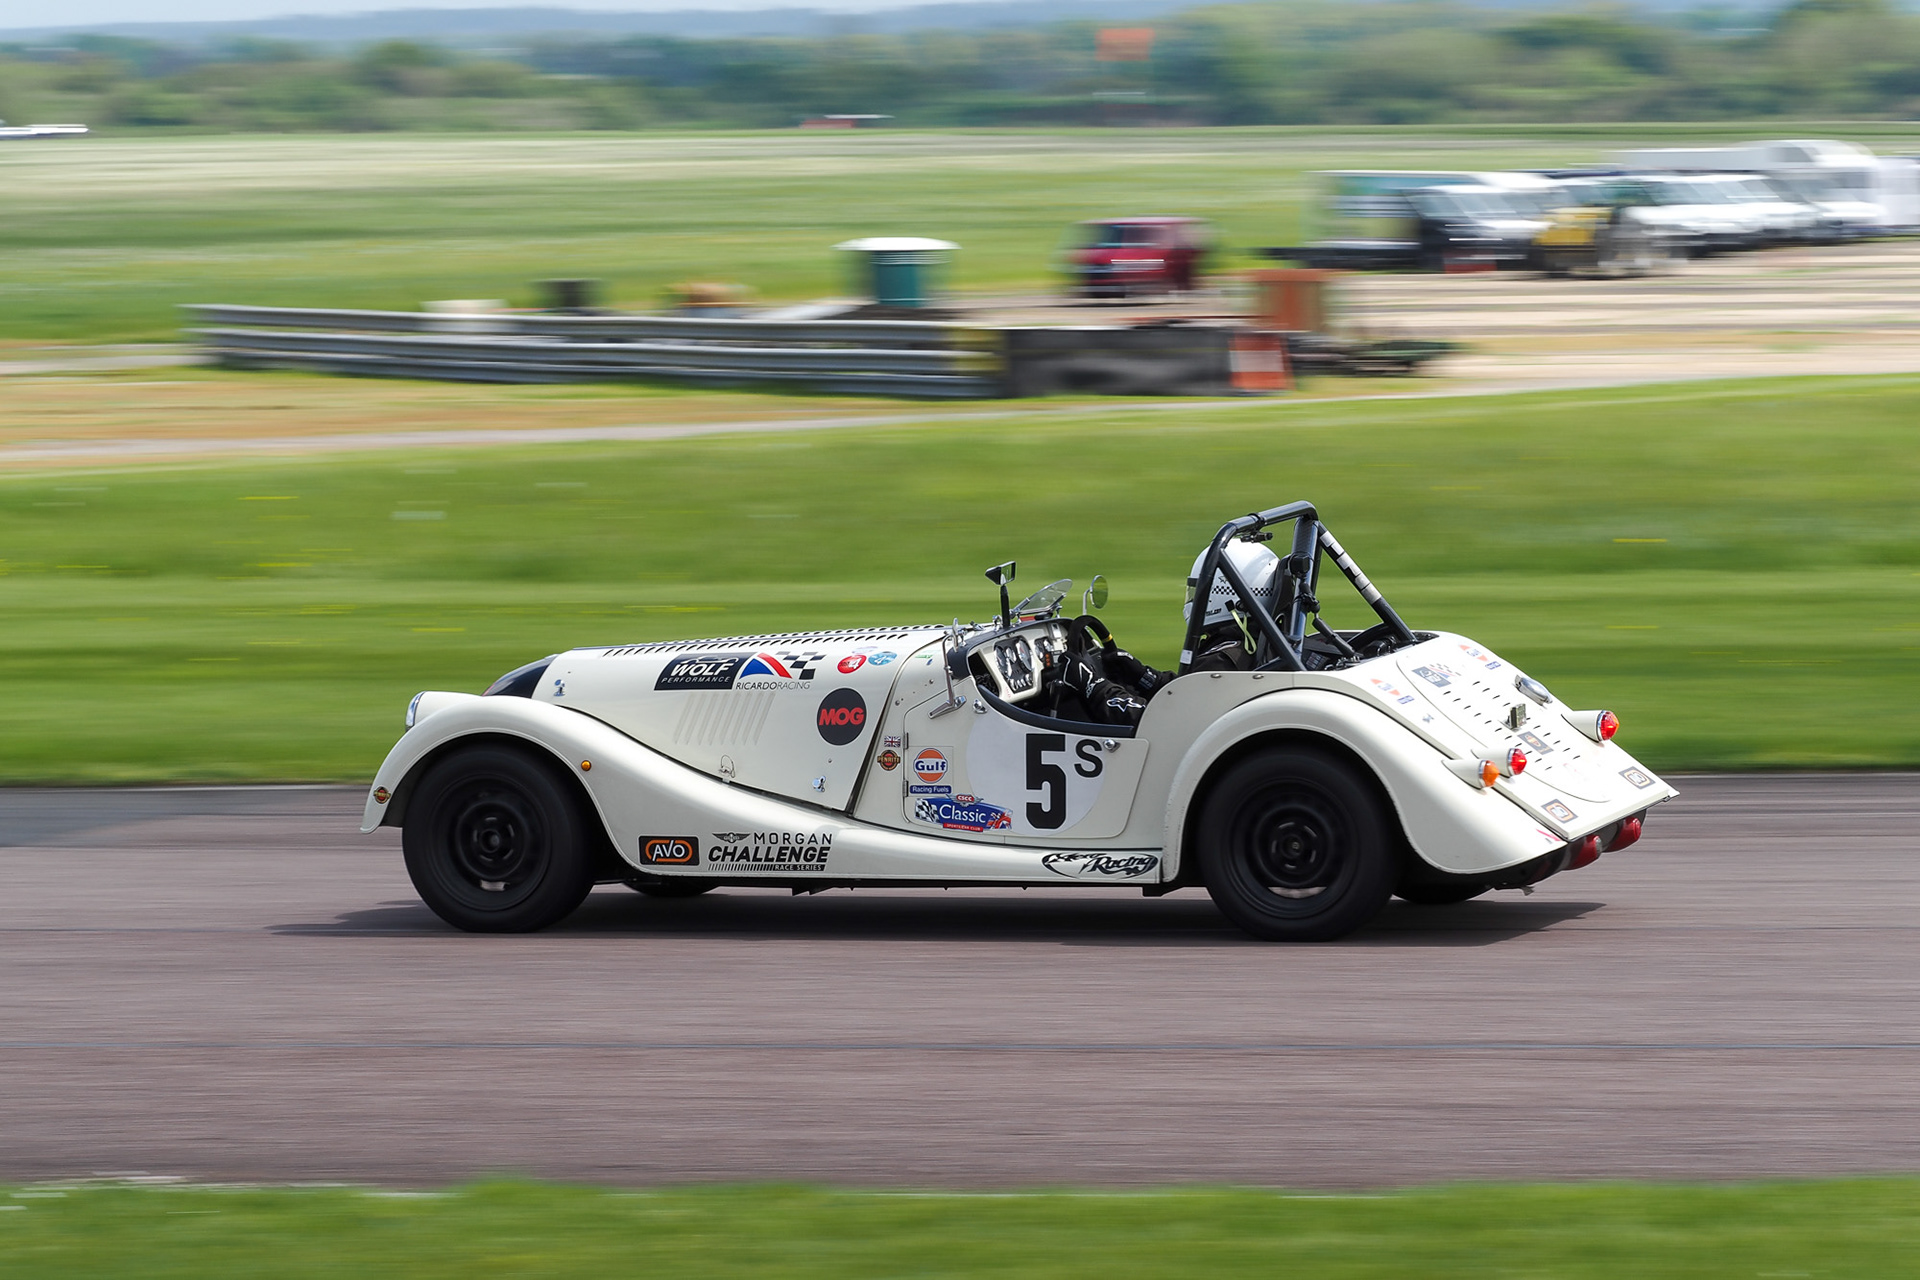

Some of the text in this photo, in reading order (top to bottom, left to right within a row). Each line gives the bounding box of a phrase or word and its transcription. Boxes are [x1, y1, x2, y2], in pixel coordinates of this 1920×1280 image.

[670, 662, 735, 677] WOLF
[661, 676, 731, 684] PERFORMANCE
[818, 707, 864, 726] MOG
[915, 760, 947, 771] Gulf
[912, 786, 933, 794] Racing
[939, 804, 986, 823] Classic
[753, 832, 832, 845] MORGAN
[652, 839, 685, 861] AVO
[708, 846, 831, 862] CHALLENGE
